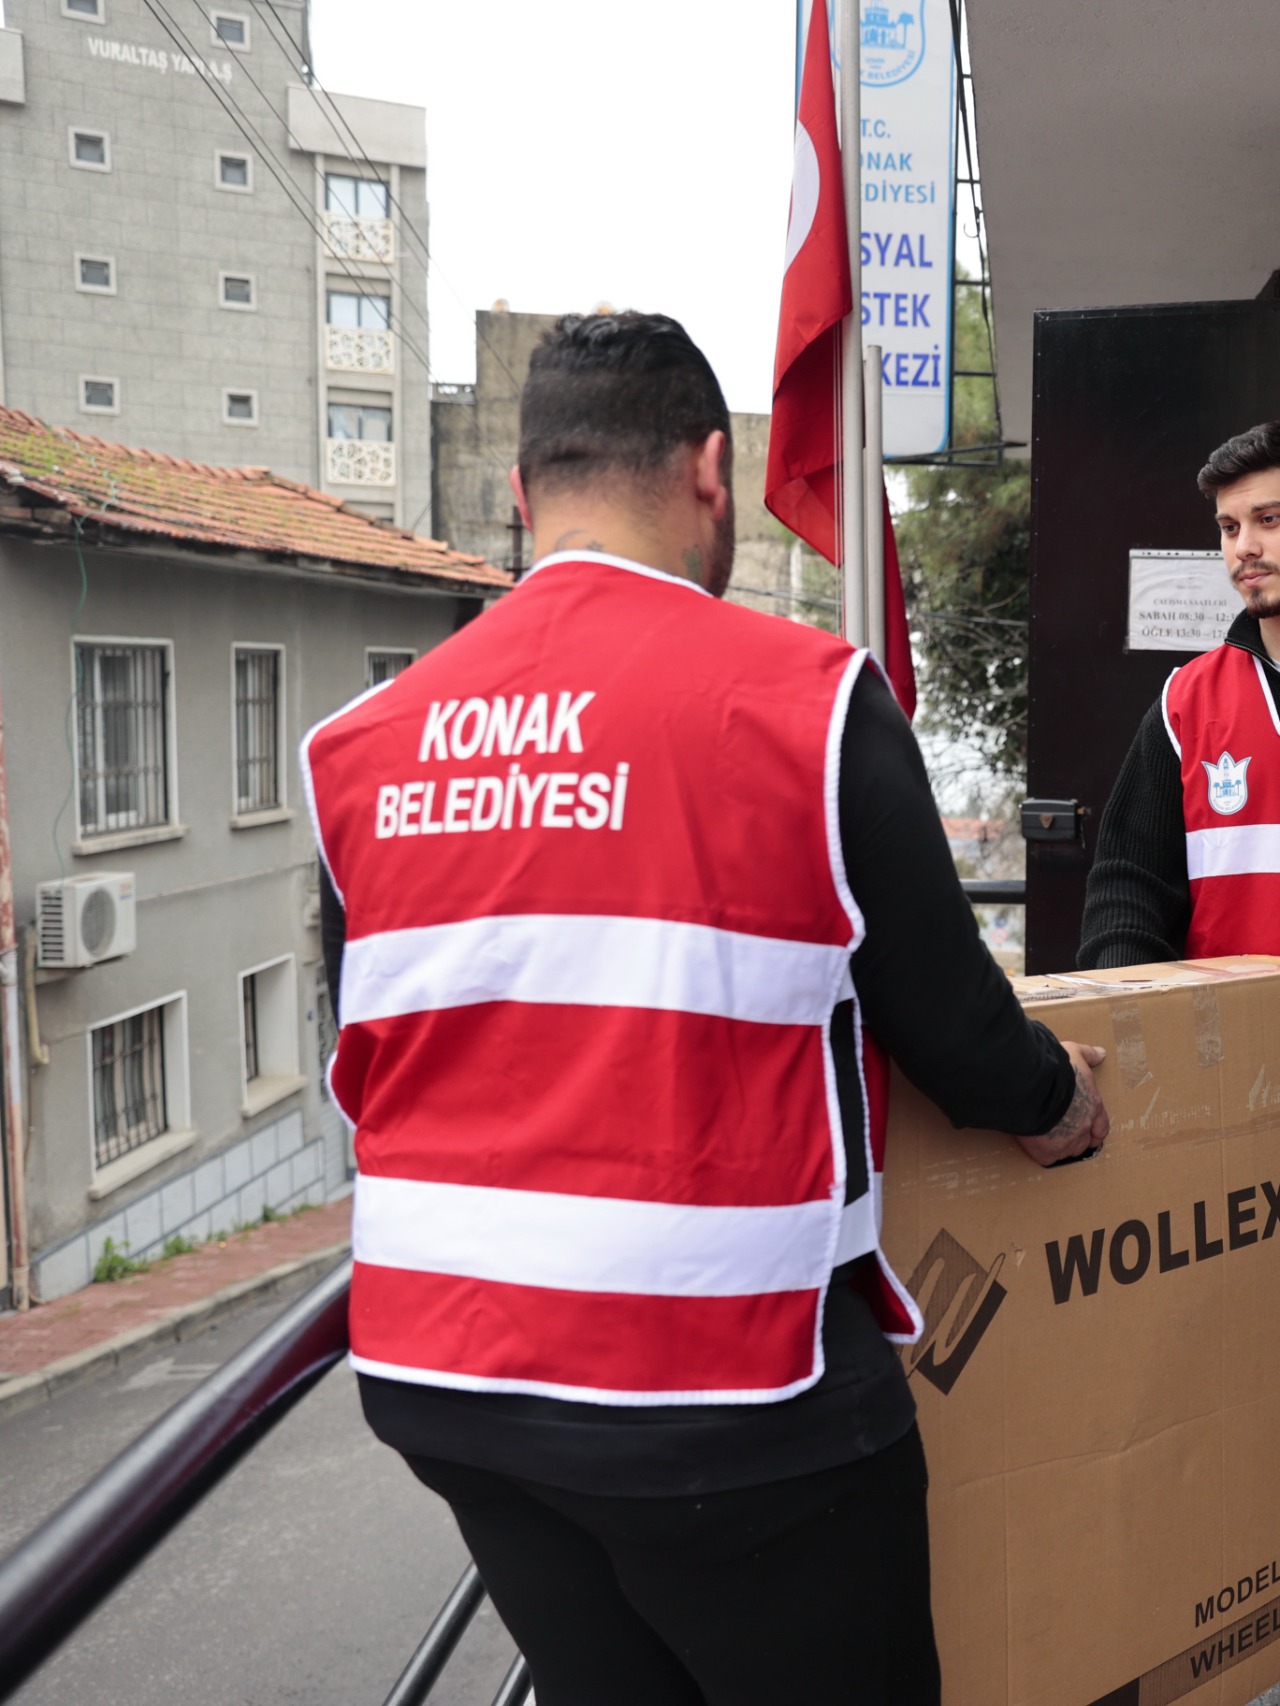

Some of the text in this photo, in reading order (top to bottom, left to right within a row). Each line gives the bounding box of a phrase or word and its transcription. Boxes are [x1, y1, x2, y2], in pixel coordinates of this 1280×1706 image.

[88, 37, 168, 74] VURALTAŞ
[860, 118, 890, 138] T.C.
[860, 152, 912, 171] NAK
[862, 179, 936, 204] DİYESİ
[860, 232, 933, 268] SYAL
[860, 291, 931, 328] STEK
[881, 343, 941, 388] KEZİ
[1138, 611, 1176, 620] SABAH
[418, 690, 597, 762] KONAK
[375, 762, 630, 839] BELEDİYESİ
